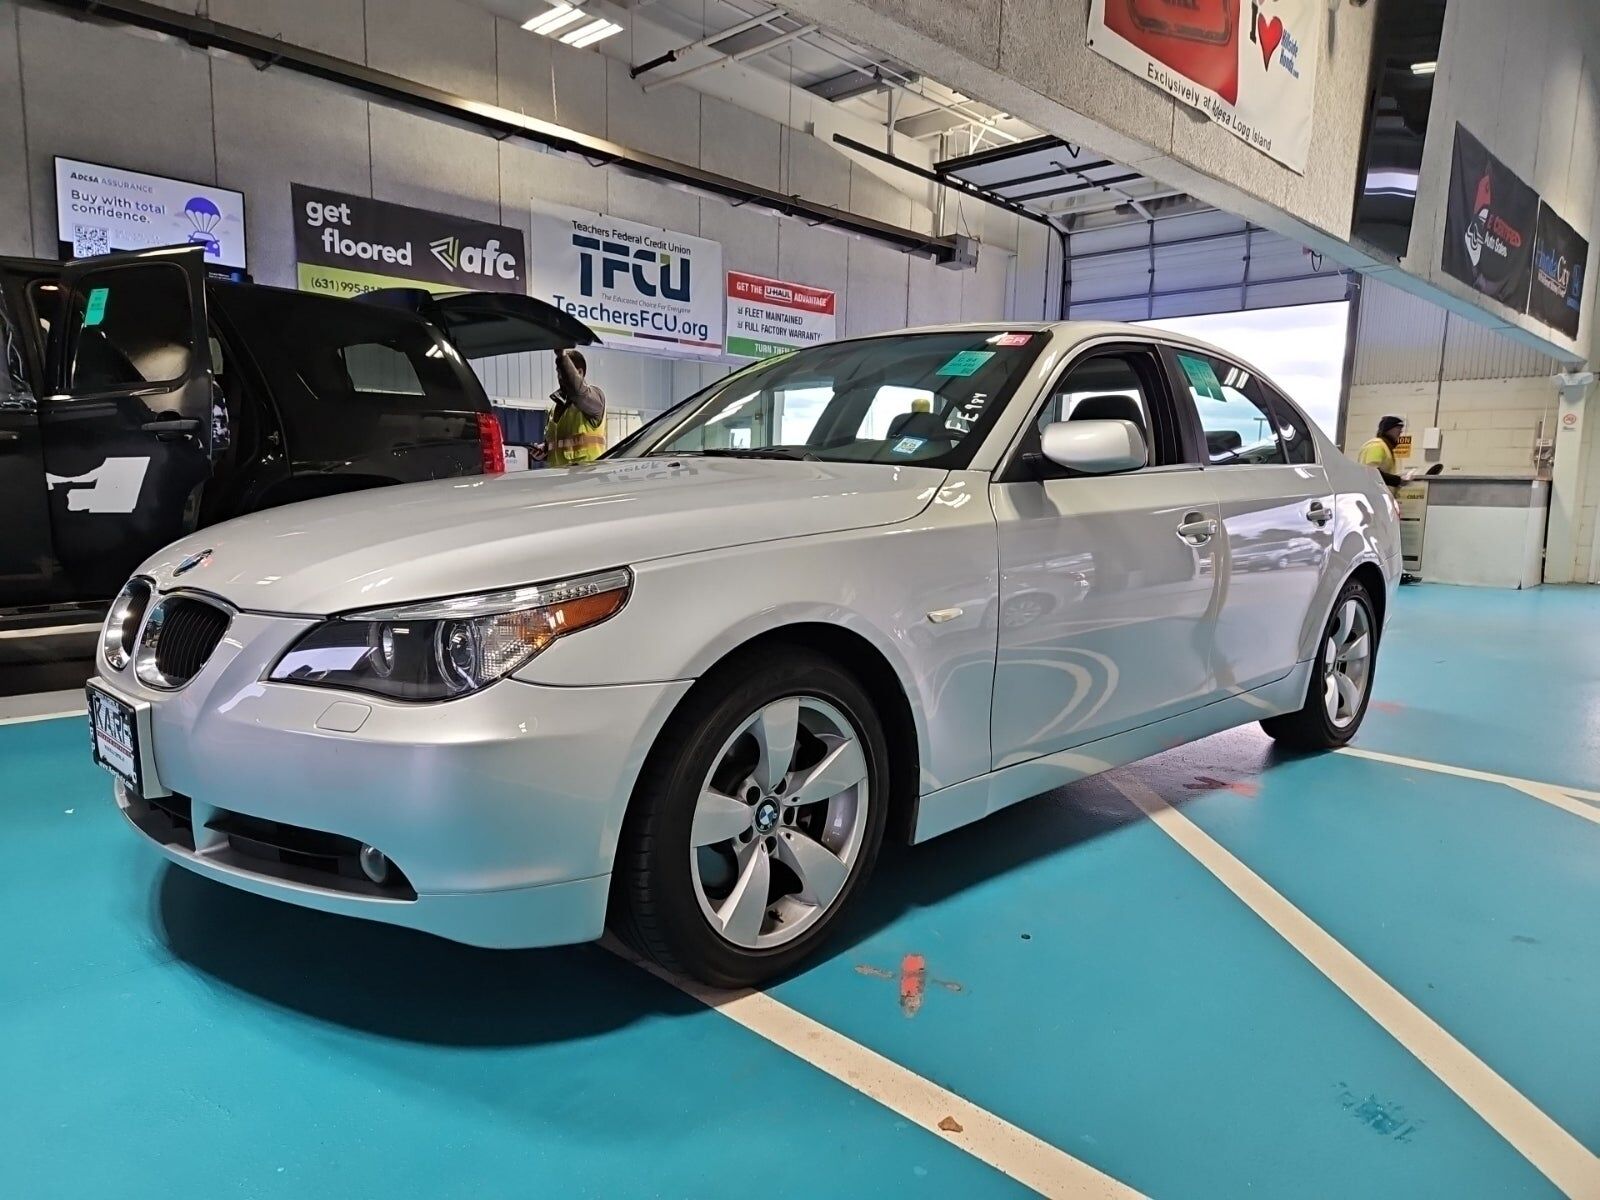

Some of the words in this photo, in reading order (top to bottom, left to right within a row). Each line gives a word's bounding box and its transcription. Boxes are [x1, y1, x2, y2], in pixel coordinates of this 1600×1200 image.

[1147, 62, 1200, 107] Exclusively
[1203, 95, 1212, 110] at
[101, 178, 153, 194] ASSURANCE
[71, 189, 98, 205] Buy
[101, 195, 132, 209] with
[135, 201, 165, 215] total
[71, 203, 151, 224] confidence.
[305, 200, 351, 226] get
[321, 227, 413, 267] floored
[572, 220, 610, 238] Teachers
[612, 229, 642, 245] Federal
[644, 236, 667, 251] Credit
[668, 242, 691, 256] Union
[572, 233, 690, 302] TFCU
[601, 292, 611, 300] The
[613, 294, 638, 305] Educated
[638, 299, 657, 309] Choice
[667, 305, 691, 314] Everyone
[736, 281, 749, 291] GET
[750, 284, 763, 294] THE
[766, 286, 791, 299] U-HAUL
[794, 292, 827, 307] ADVANTAGE
[553, 295, 708, 341] TeachersFCU.org
[744, 321, 760, 333] FULL
[761, 324, 787, 337] FACTORY
[745, 307, 763, 319] FLEET
[765, 311, 803, 325] MAINTAINED
[754, 343, 772, 353] TURN
